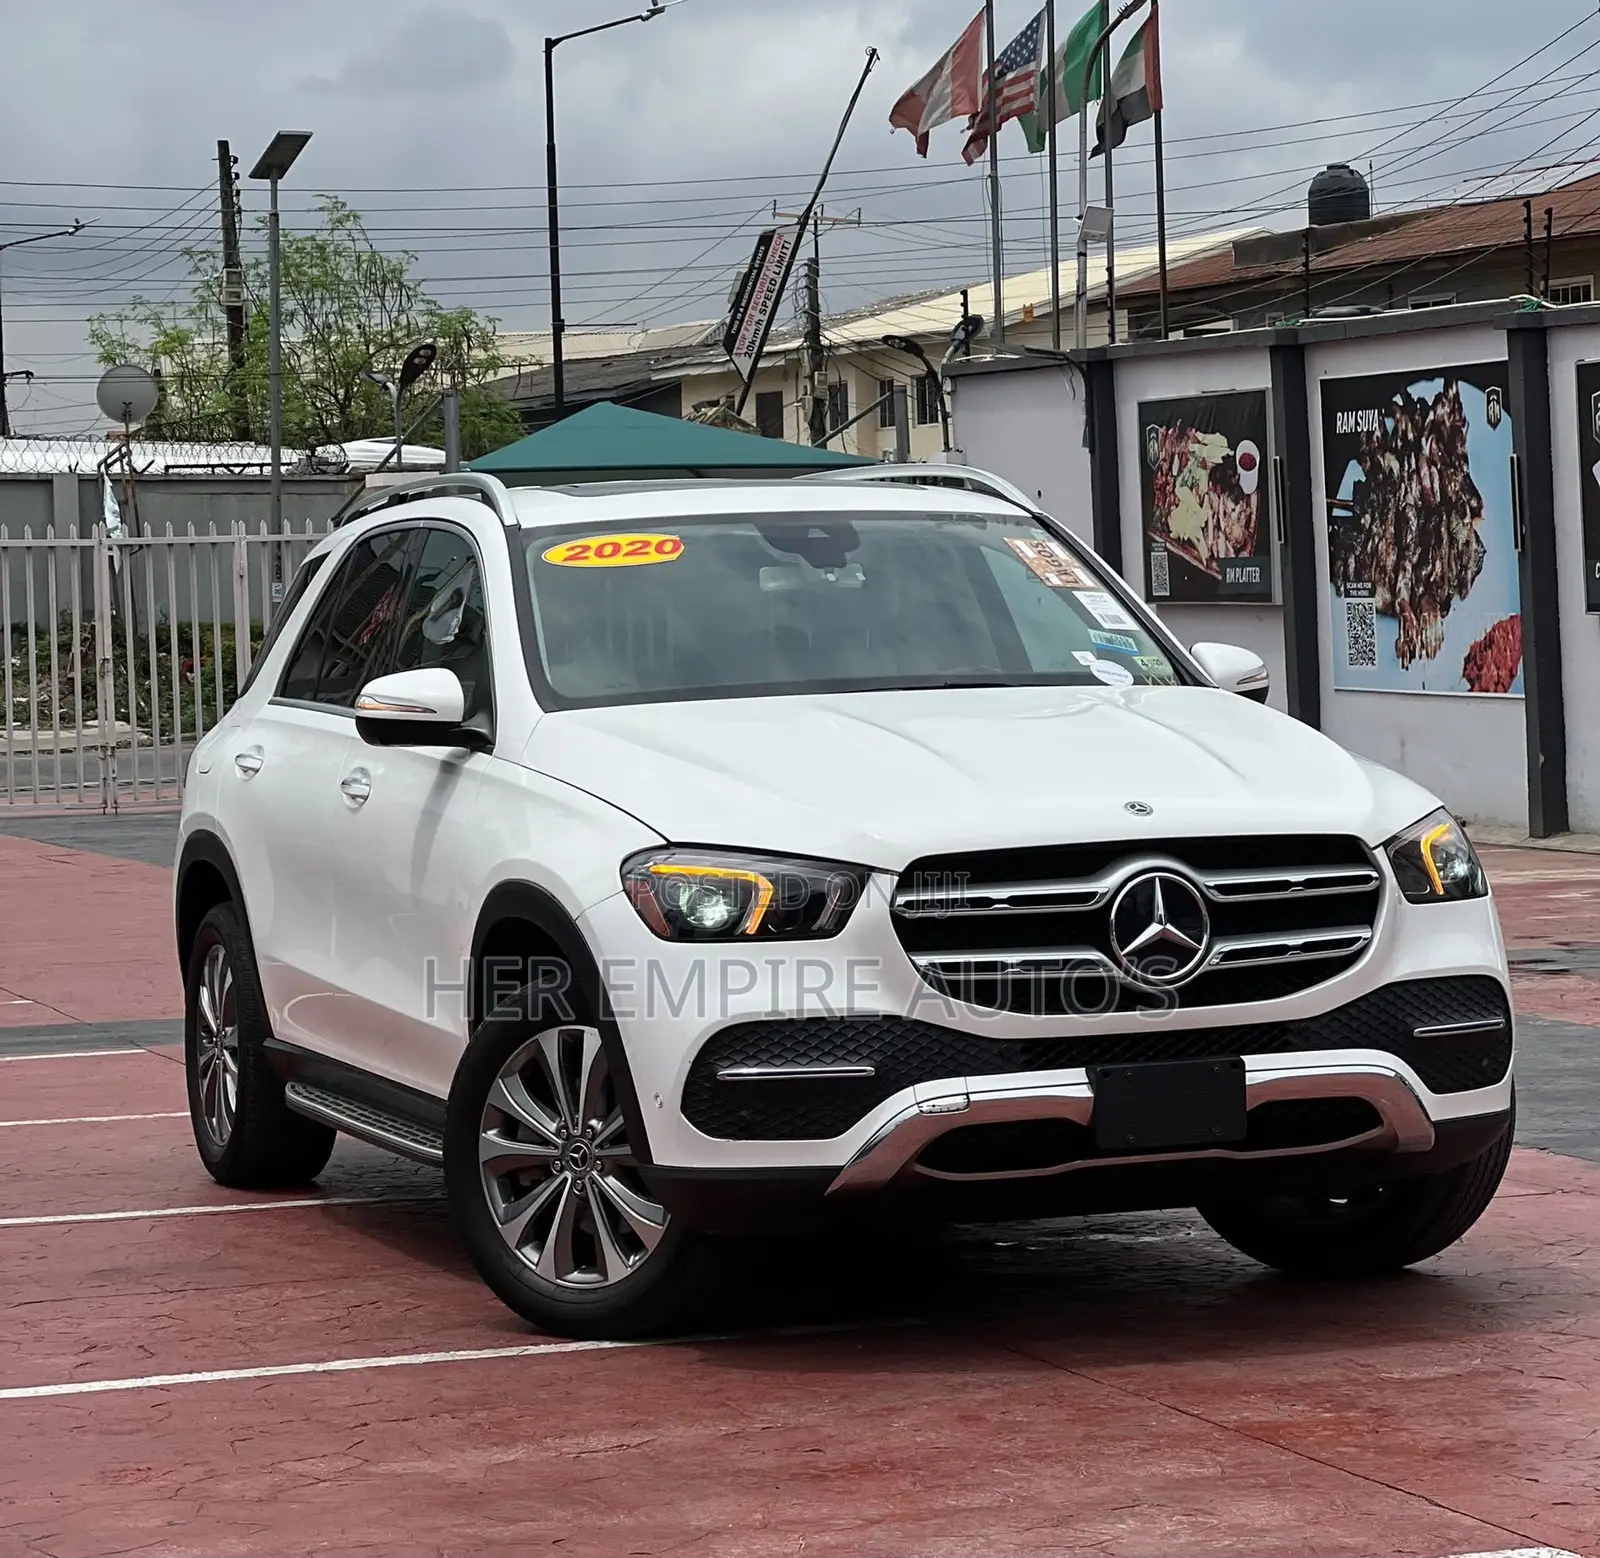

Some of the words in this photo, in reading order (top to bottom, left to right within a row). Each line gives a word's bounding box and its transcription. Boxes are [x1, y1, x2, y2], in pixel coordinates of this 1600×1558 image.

[735, 333, 747, 357] STOP
[743, 312, 755, 332] FOR
[751, 265, 772, 312] SECURITY
[768, 233, 785, 264] CHECK
[743, 319, 765, 359] 20km/h
[759, 278, 778, 316] SPEED
[772, 240, 792, 275] LIMIT!
[1336, 411, 1356, 434] RAM
[1356, 409, 1379, 432] SUYA
[562, 539, 682, 562] 2020
[1235, 566, 1261, 583] PLATTER
